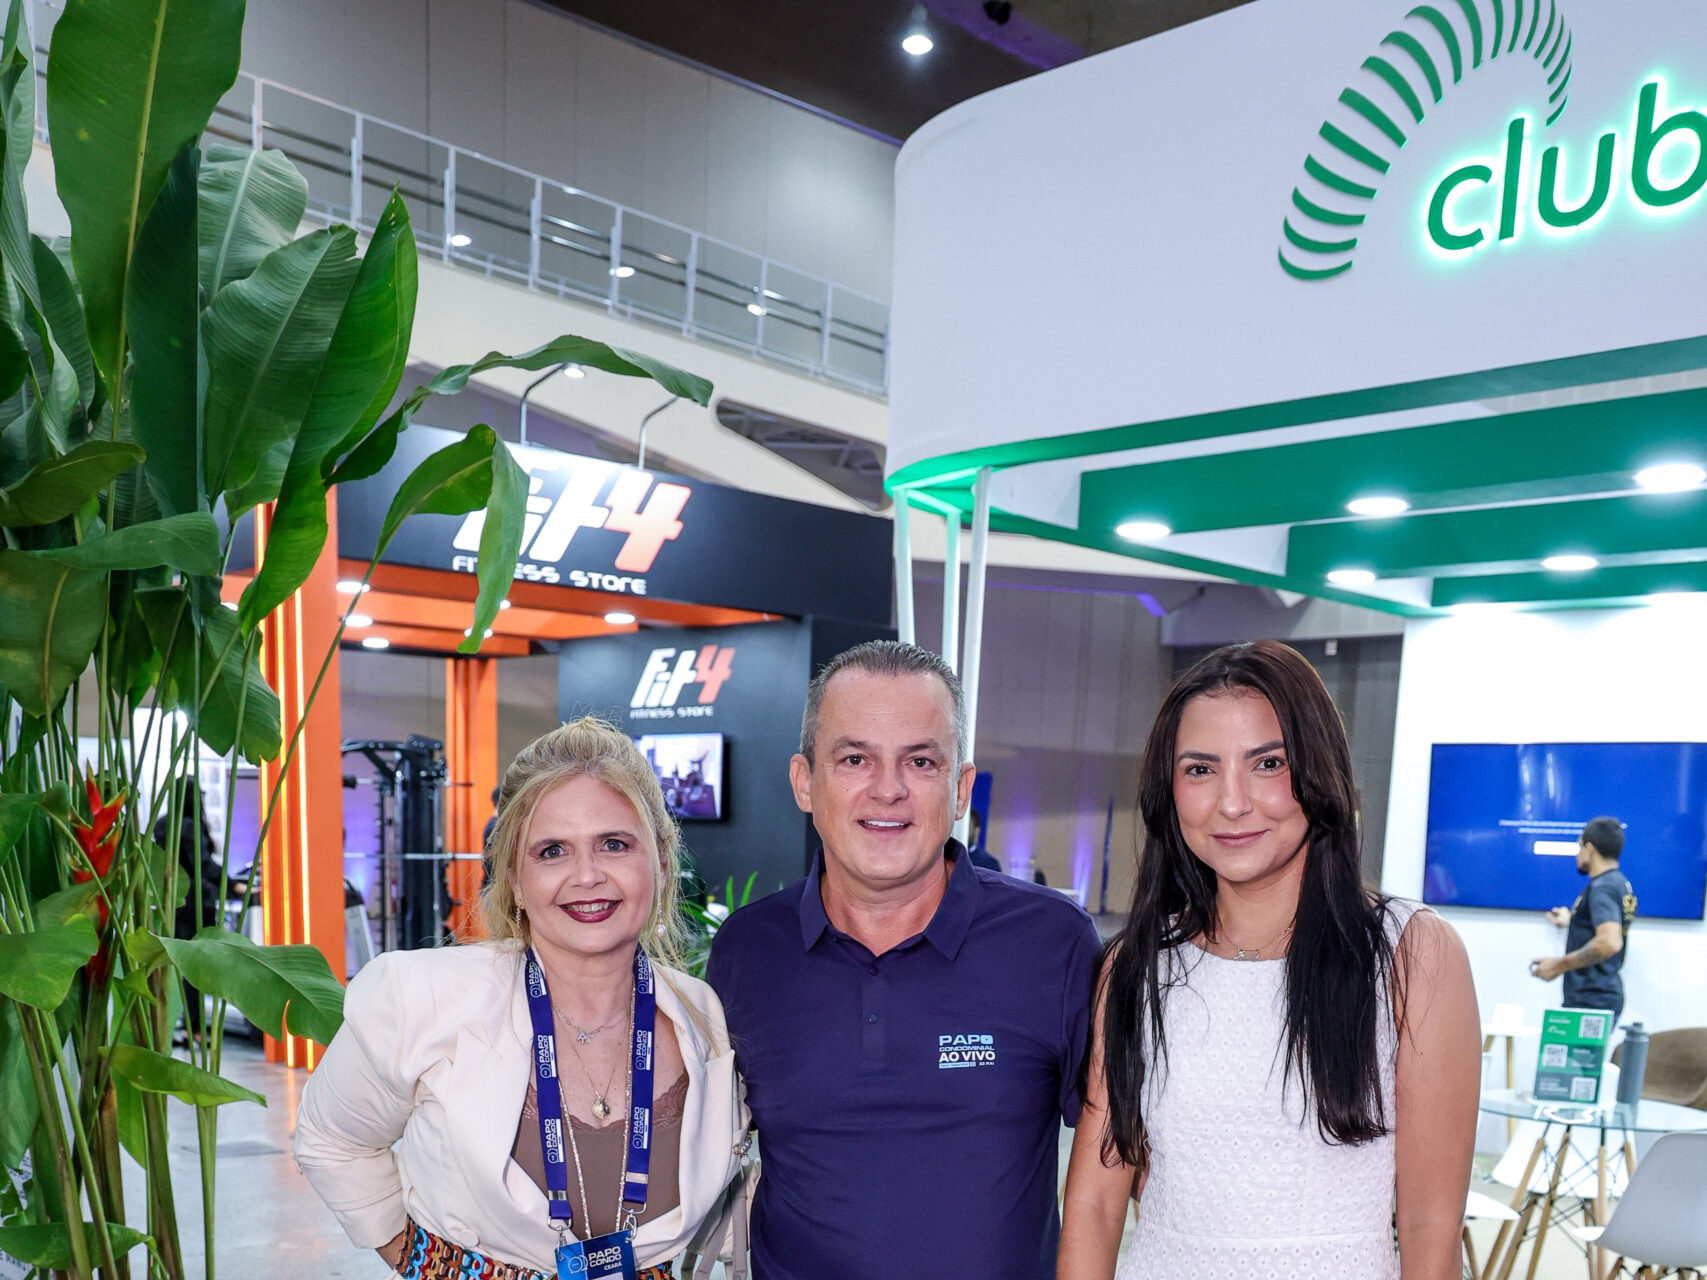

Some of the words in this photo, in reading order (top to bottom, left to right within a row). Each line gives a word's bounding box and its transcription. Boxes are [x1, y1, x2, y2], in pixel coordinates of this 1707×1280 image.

[1427, 82, 1707, 250] club
[537, 1034, 546, 1063] PAPO
[939, 1034, 994, 1046] PAPO
[938, 1051, 960, 1063] AO
[961, 1050, 996, 1061] VIVO
[633, 1106, 641, 1134] PAPO
[544, 1118, 553, 1148] PAPO
[588, 1246, 621, 1261] PAPO
[589, 1254, 622, 1268] CONDO
